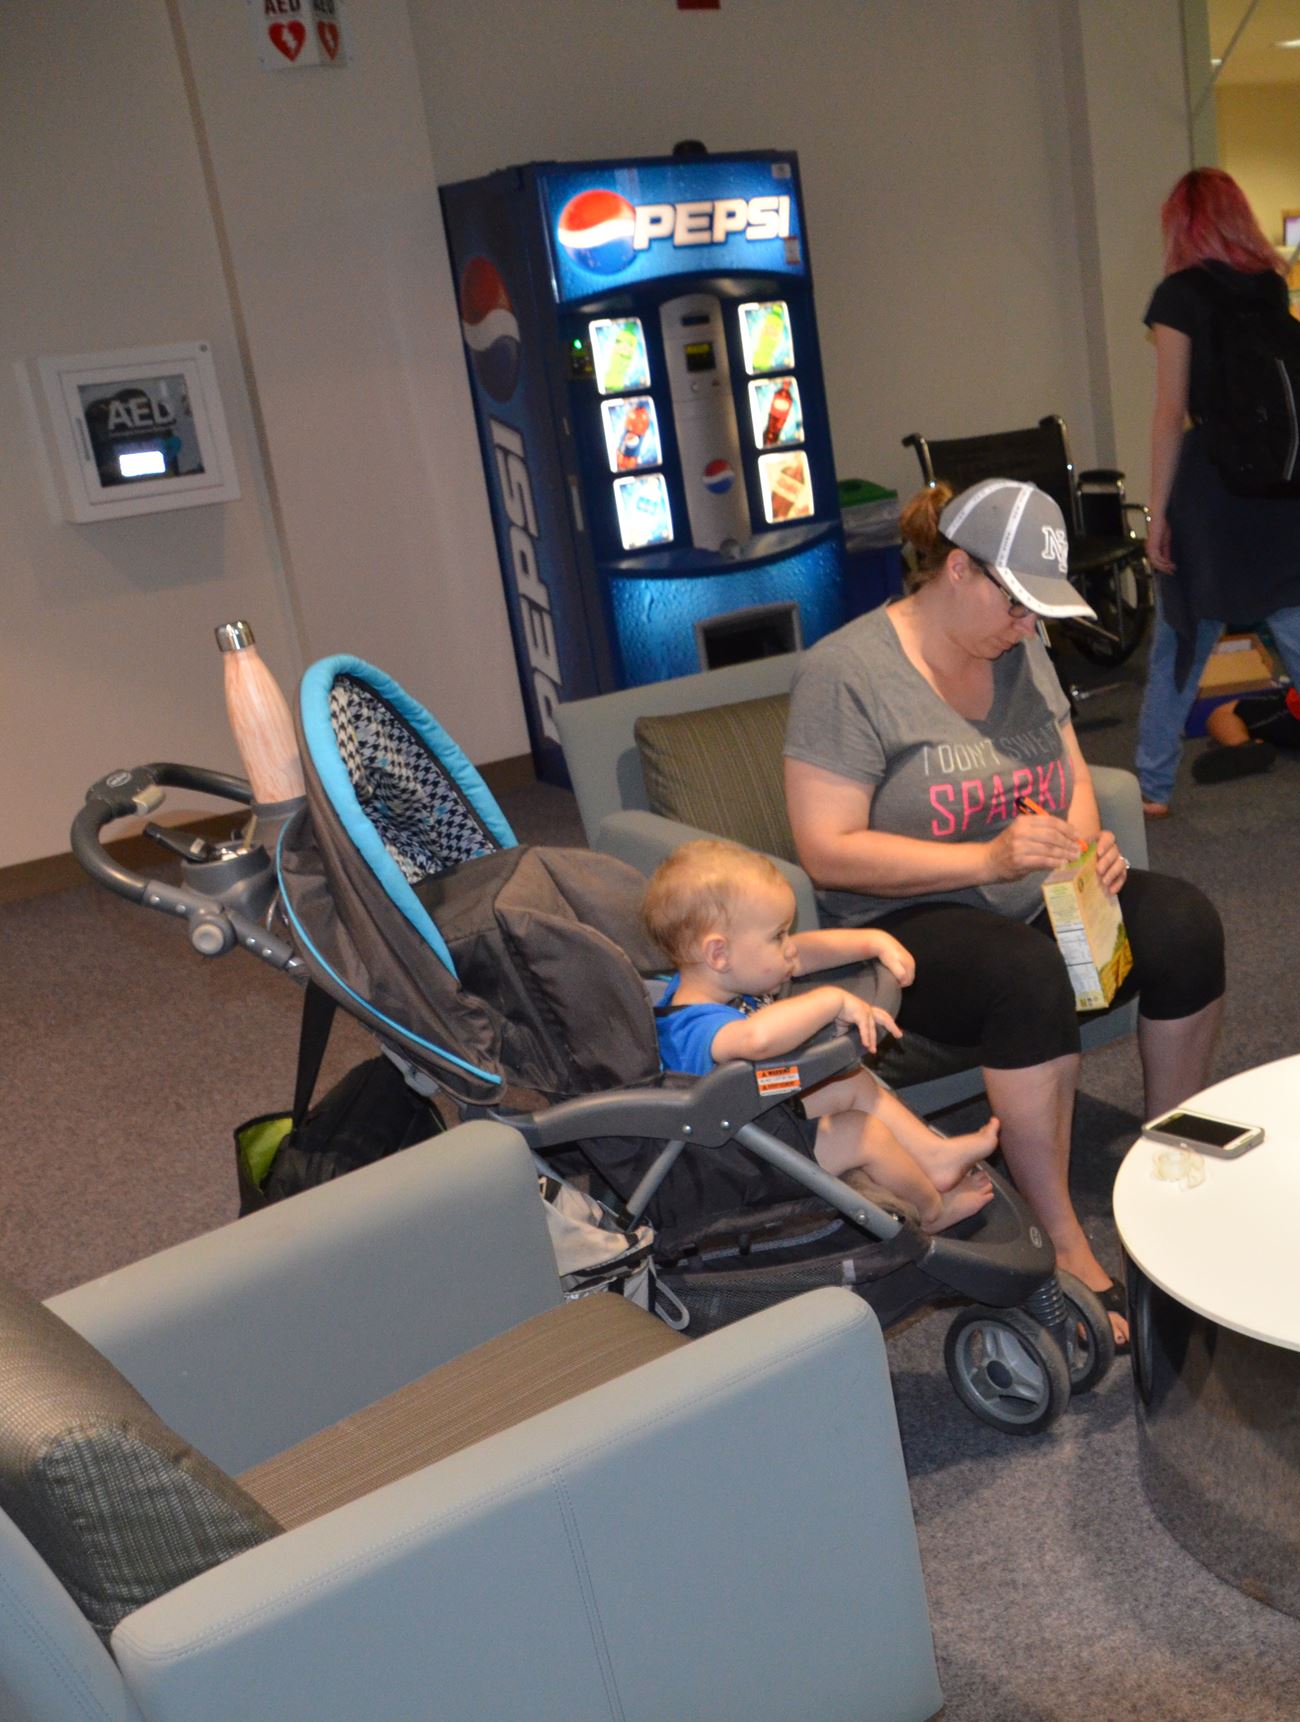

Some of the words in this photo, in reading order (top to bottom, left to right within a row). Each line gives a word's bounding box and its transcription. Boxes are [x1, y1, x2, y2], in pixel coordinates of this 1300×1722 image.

[265, 0, 301, 14] AED
[633, 195, 790, 251] PEPSI
[108, 397, 177, 430] AED
[489, 416, 563, 746] PEPSI
[938, 738, 1001, 774] DON'T
[928, 756, 1075, 837] SPARKL
